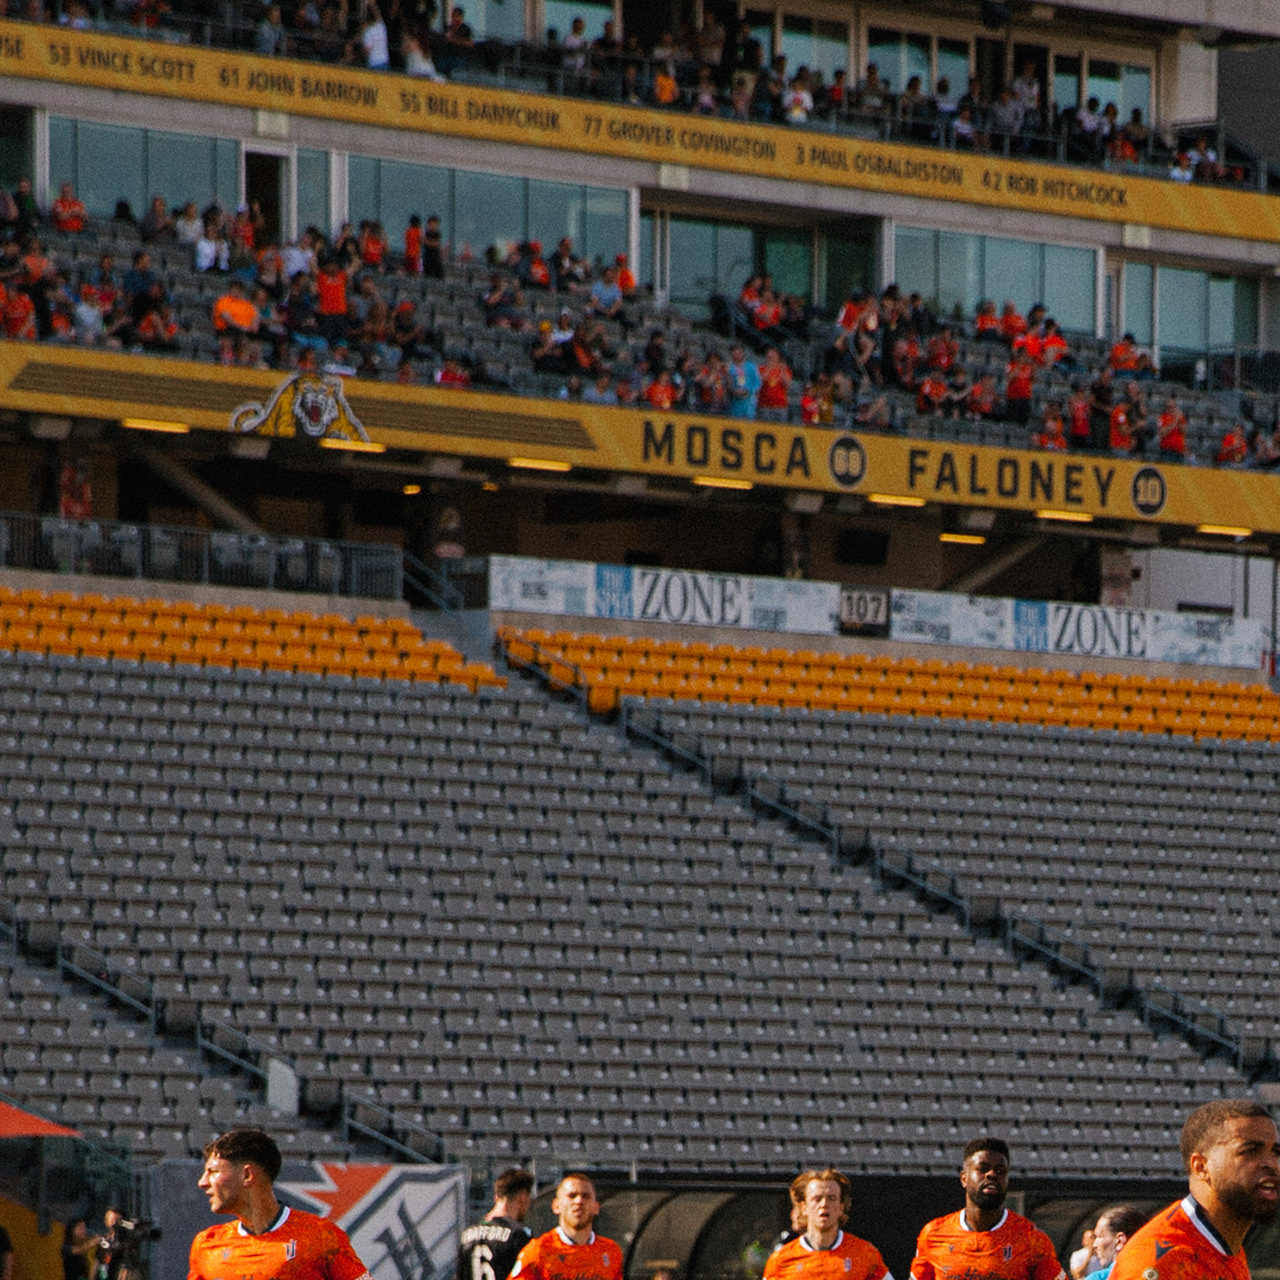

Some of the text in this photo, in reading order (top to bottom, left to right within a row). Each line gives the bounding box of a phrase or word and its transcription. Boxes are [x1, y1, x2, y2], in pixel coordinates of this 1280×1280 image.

[77, 46, 131, 74] VINCE
[139, 53, 196, 82] SCOTT
[247, 70, 295, 96] JOHN
[300, 76, 380, 107] BARROW
[426, 94, 460, 119] BILL
[466, 97, 561, 132] DANYCHUK
[582, 115, 777, 161] 77 GROVER COVINGTON
[810, 147, 850, 173] PAUL
[981, 168, 1128, 206] 42 ROB HITCHCOCK
[642, 419, 811, 479] MOSCA
[908, 448, 1117, 508] FALONEY
[1132, 477, 1162, 504] 10
[638, 568, 744, 627] ZONE
[843, 592, 886, 622] 107
[1053, 603, 1148, 658] ZONE
